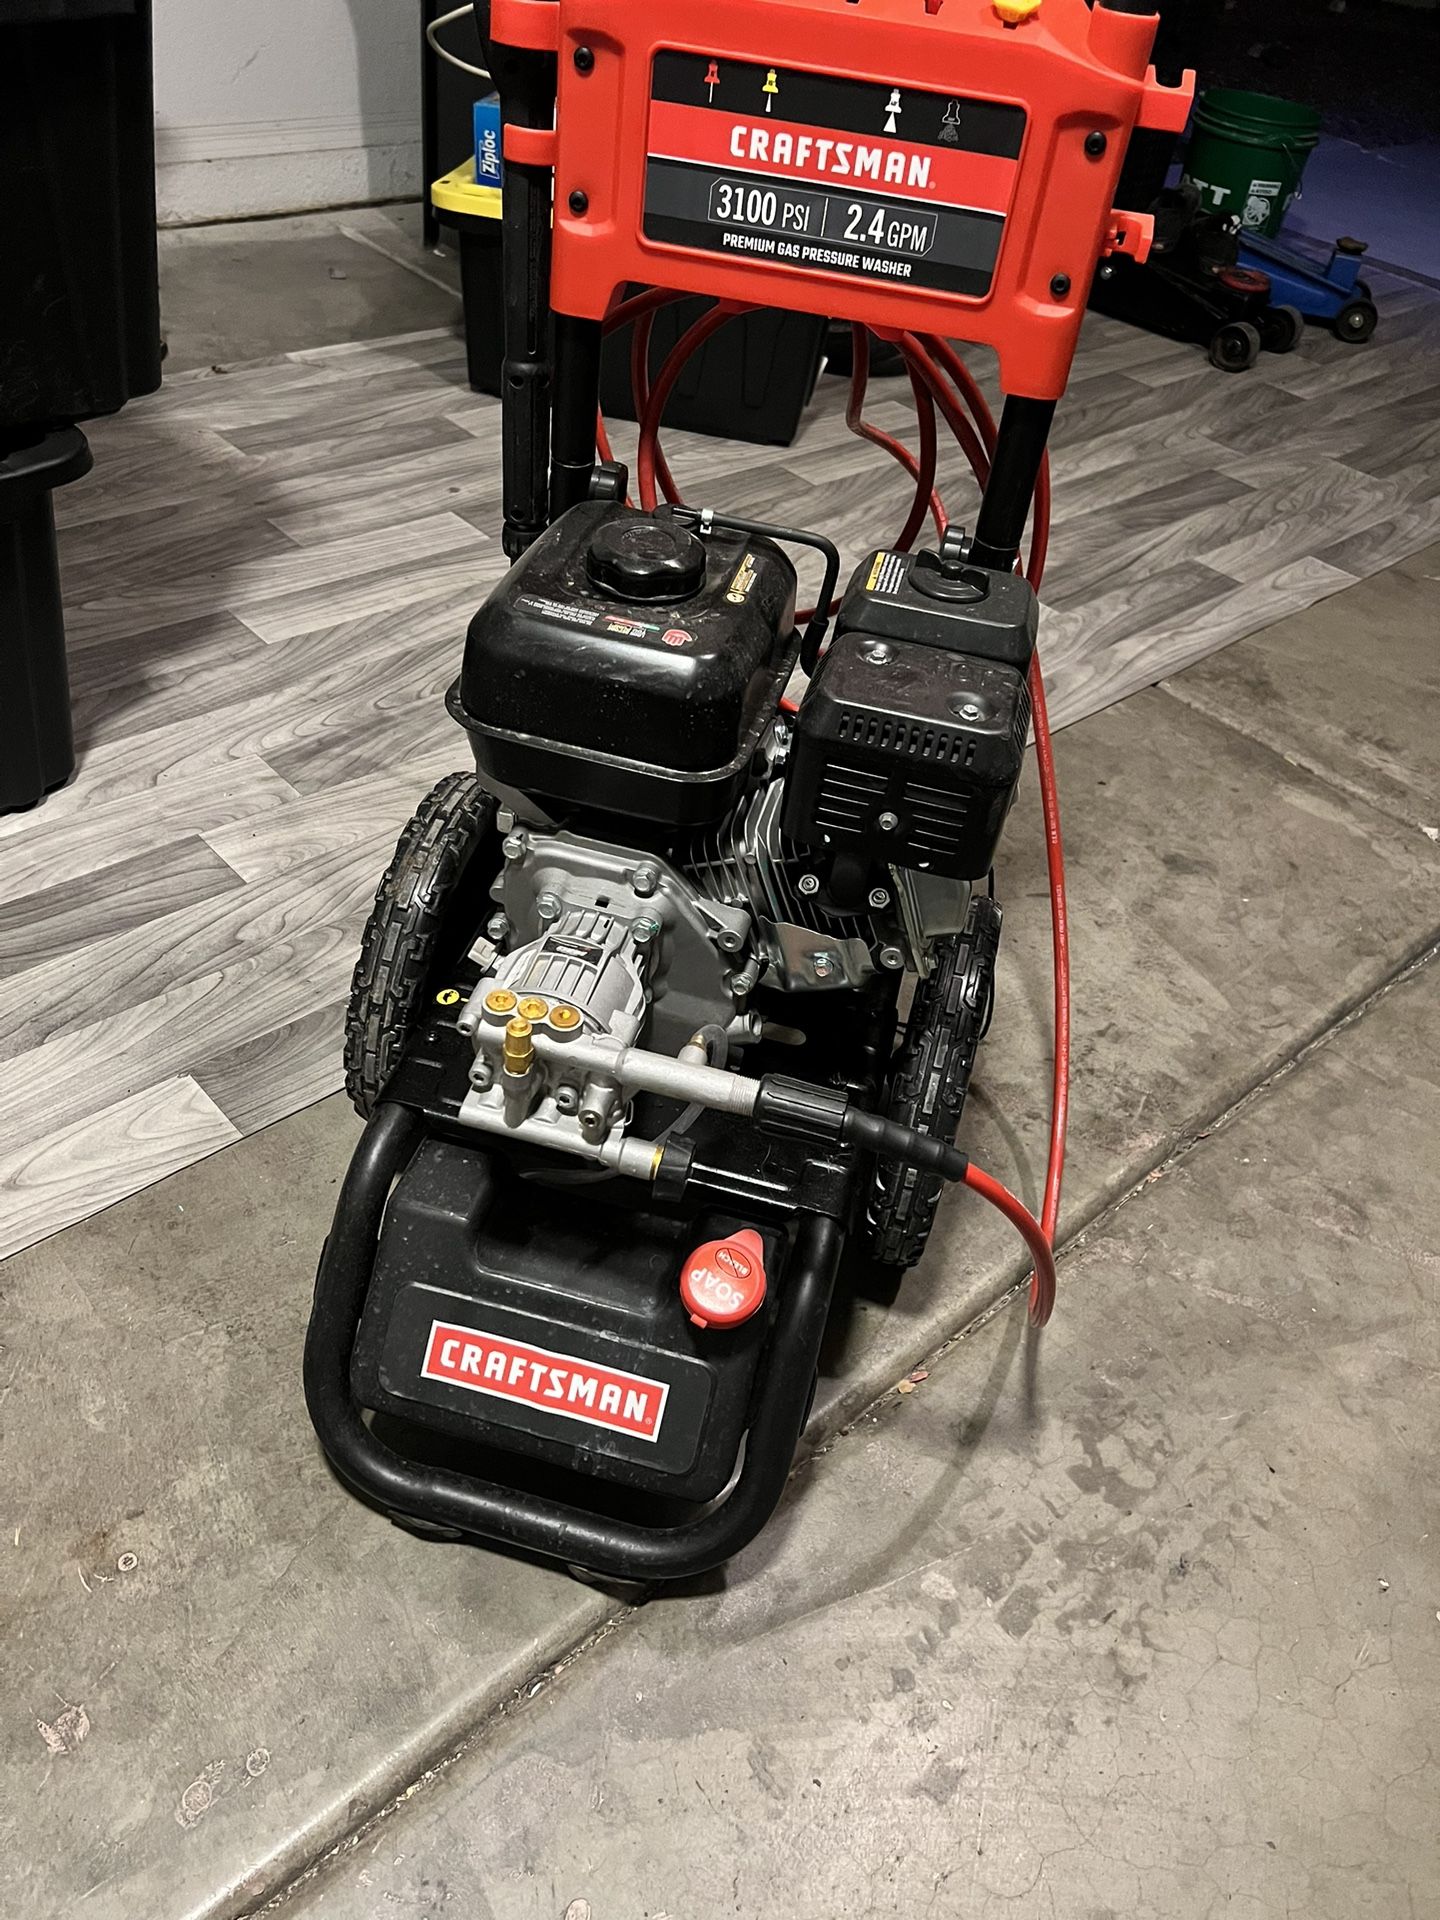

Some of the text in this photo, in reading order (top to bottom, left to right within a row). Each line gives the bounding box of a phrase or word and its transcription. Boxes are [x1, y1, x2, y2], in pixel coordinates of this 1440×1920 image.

[482, 130, 500, 174] Ziploc
[730, 125, 932, 189] CRAFTSMAN
[716, 184, 928, 252] 3100 PSI 2.4 GPM
[722, 232, 912, 278] PREMIUM GAS PRESSURE WASHER
[690, 1267, 745, 1310] SOAP
[440, 1339, 648, 1422] CRAFTSMAN
